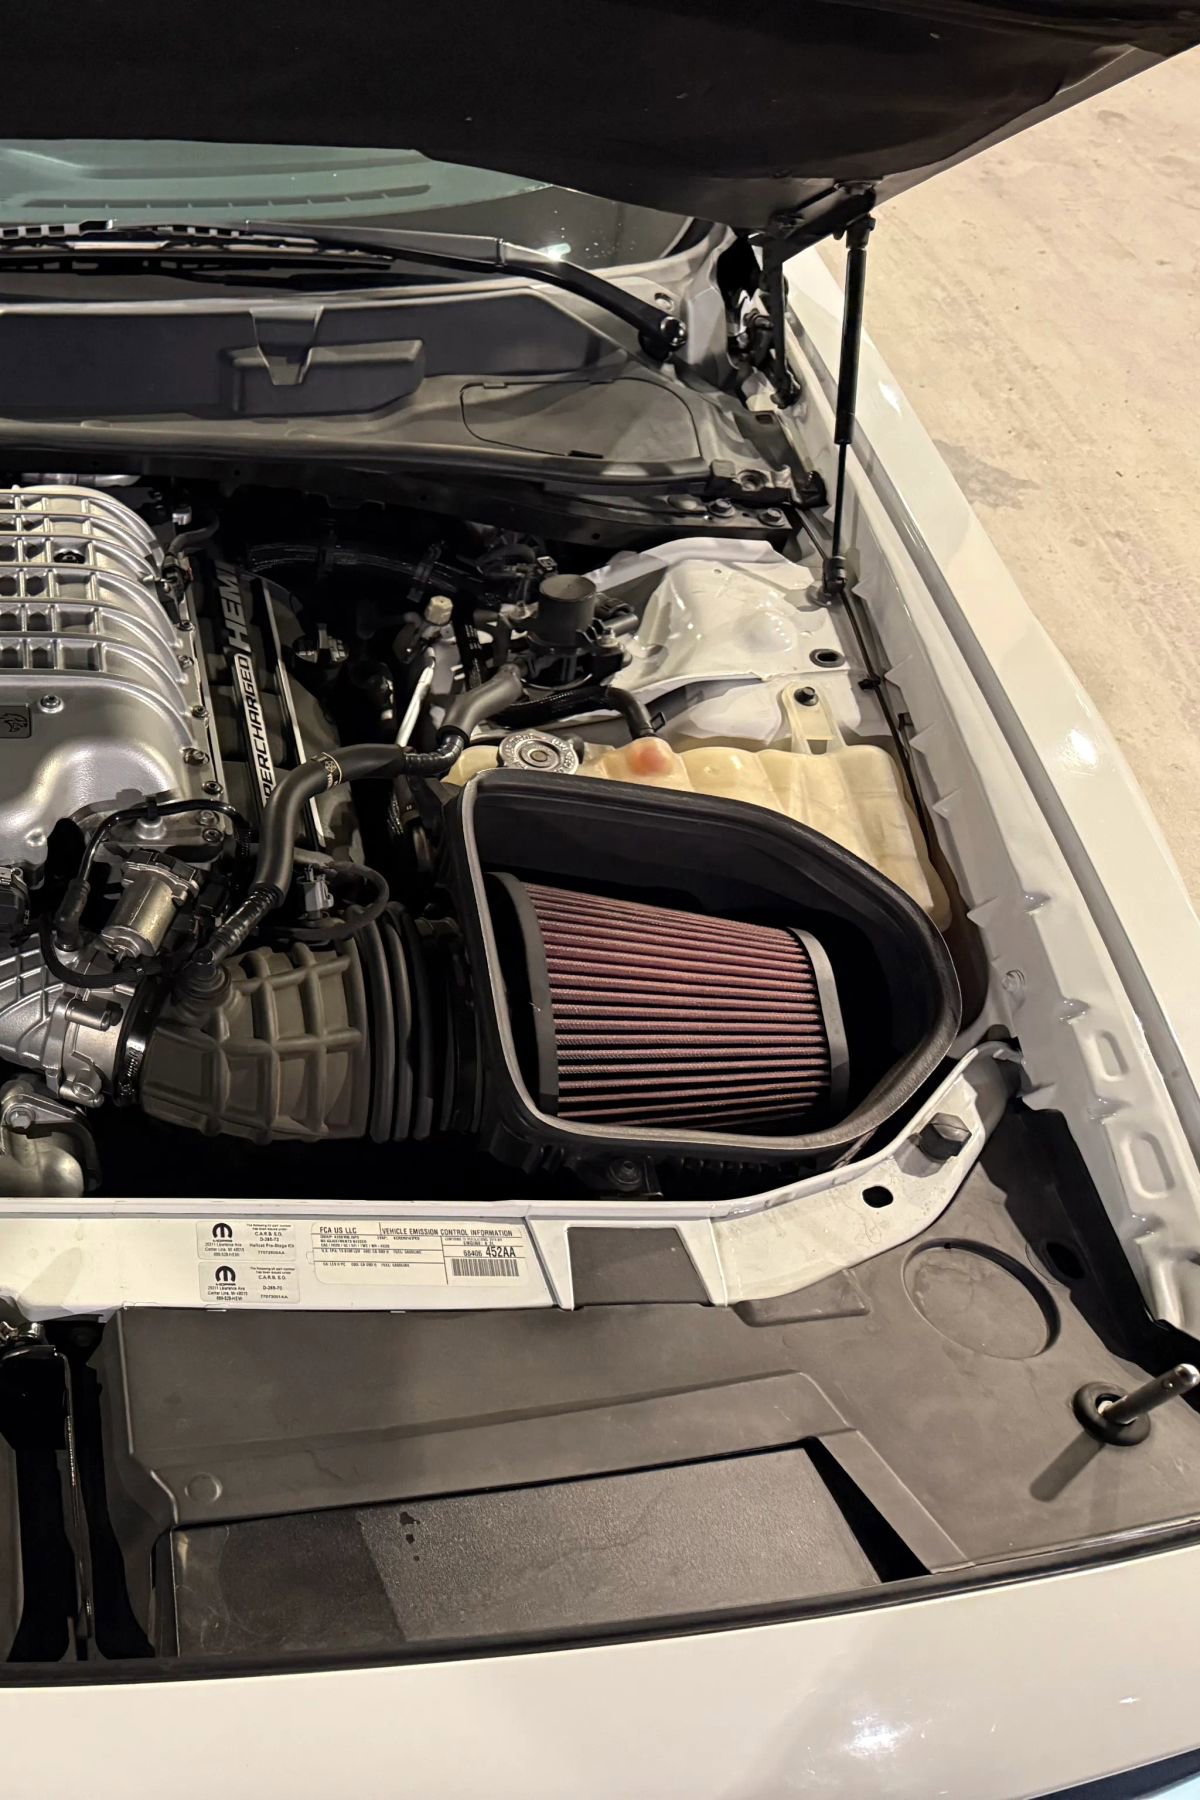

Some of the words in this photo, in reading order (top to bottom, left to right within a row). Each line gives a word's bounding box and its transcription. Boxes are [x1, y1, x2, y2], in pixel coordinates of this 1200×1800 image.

[213, 559, 252, 654] HEMI
[236, 655, 274, 797] PERCHARGED
[319, 1226, 332, 1234] FCA
[409, 1228, 439, 1236] EMISSION
[440, 1228, 468, 1236] CONTROL
[470, 1229, 513, 1237] INFORMATION
[485, 1246, 517, 1258] 452AA
